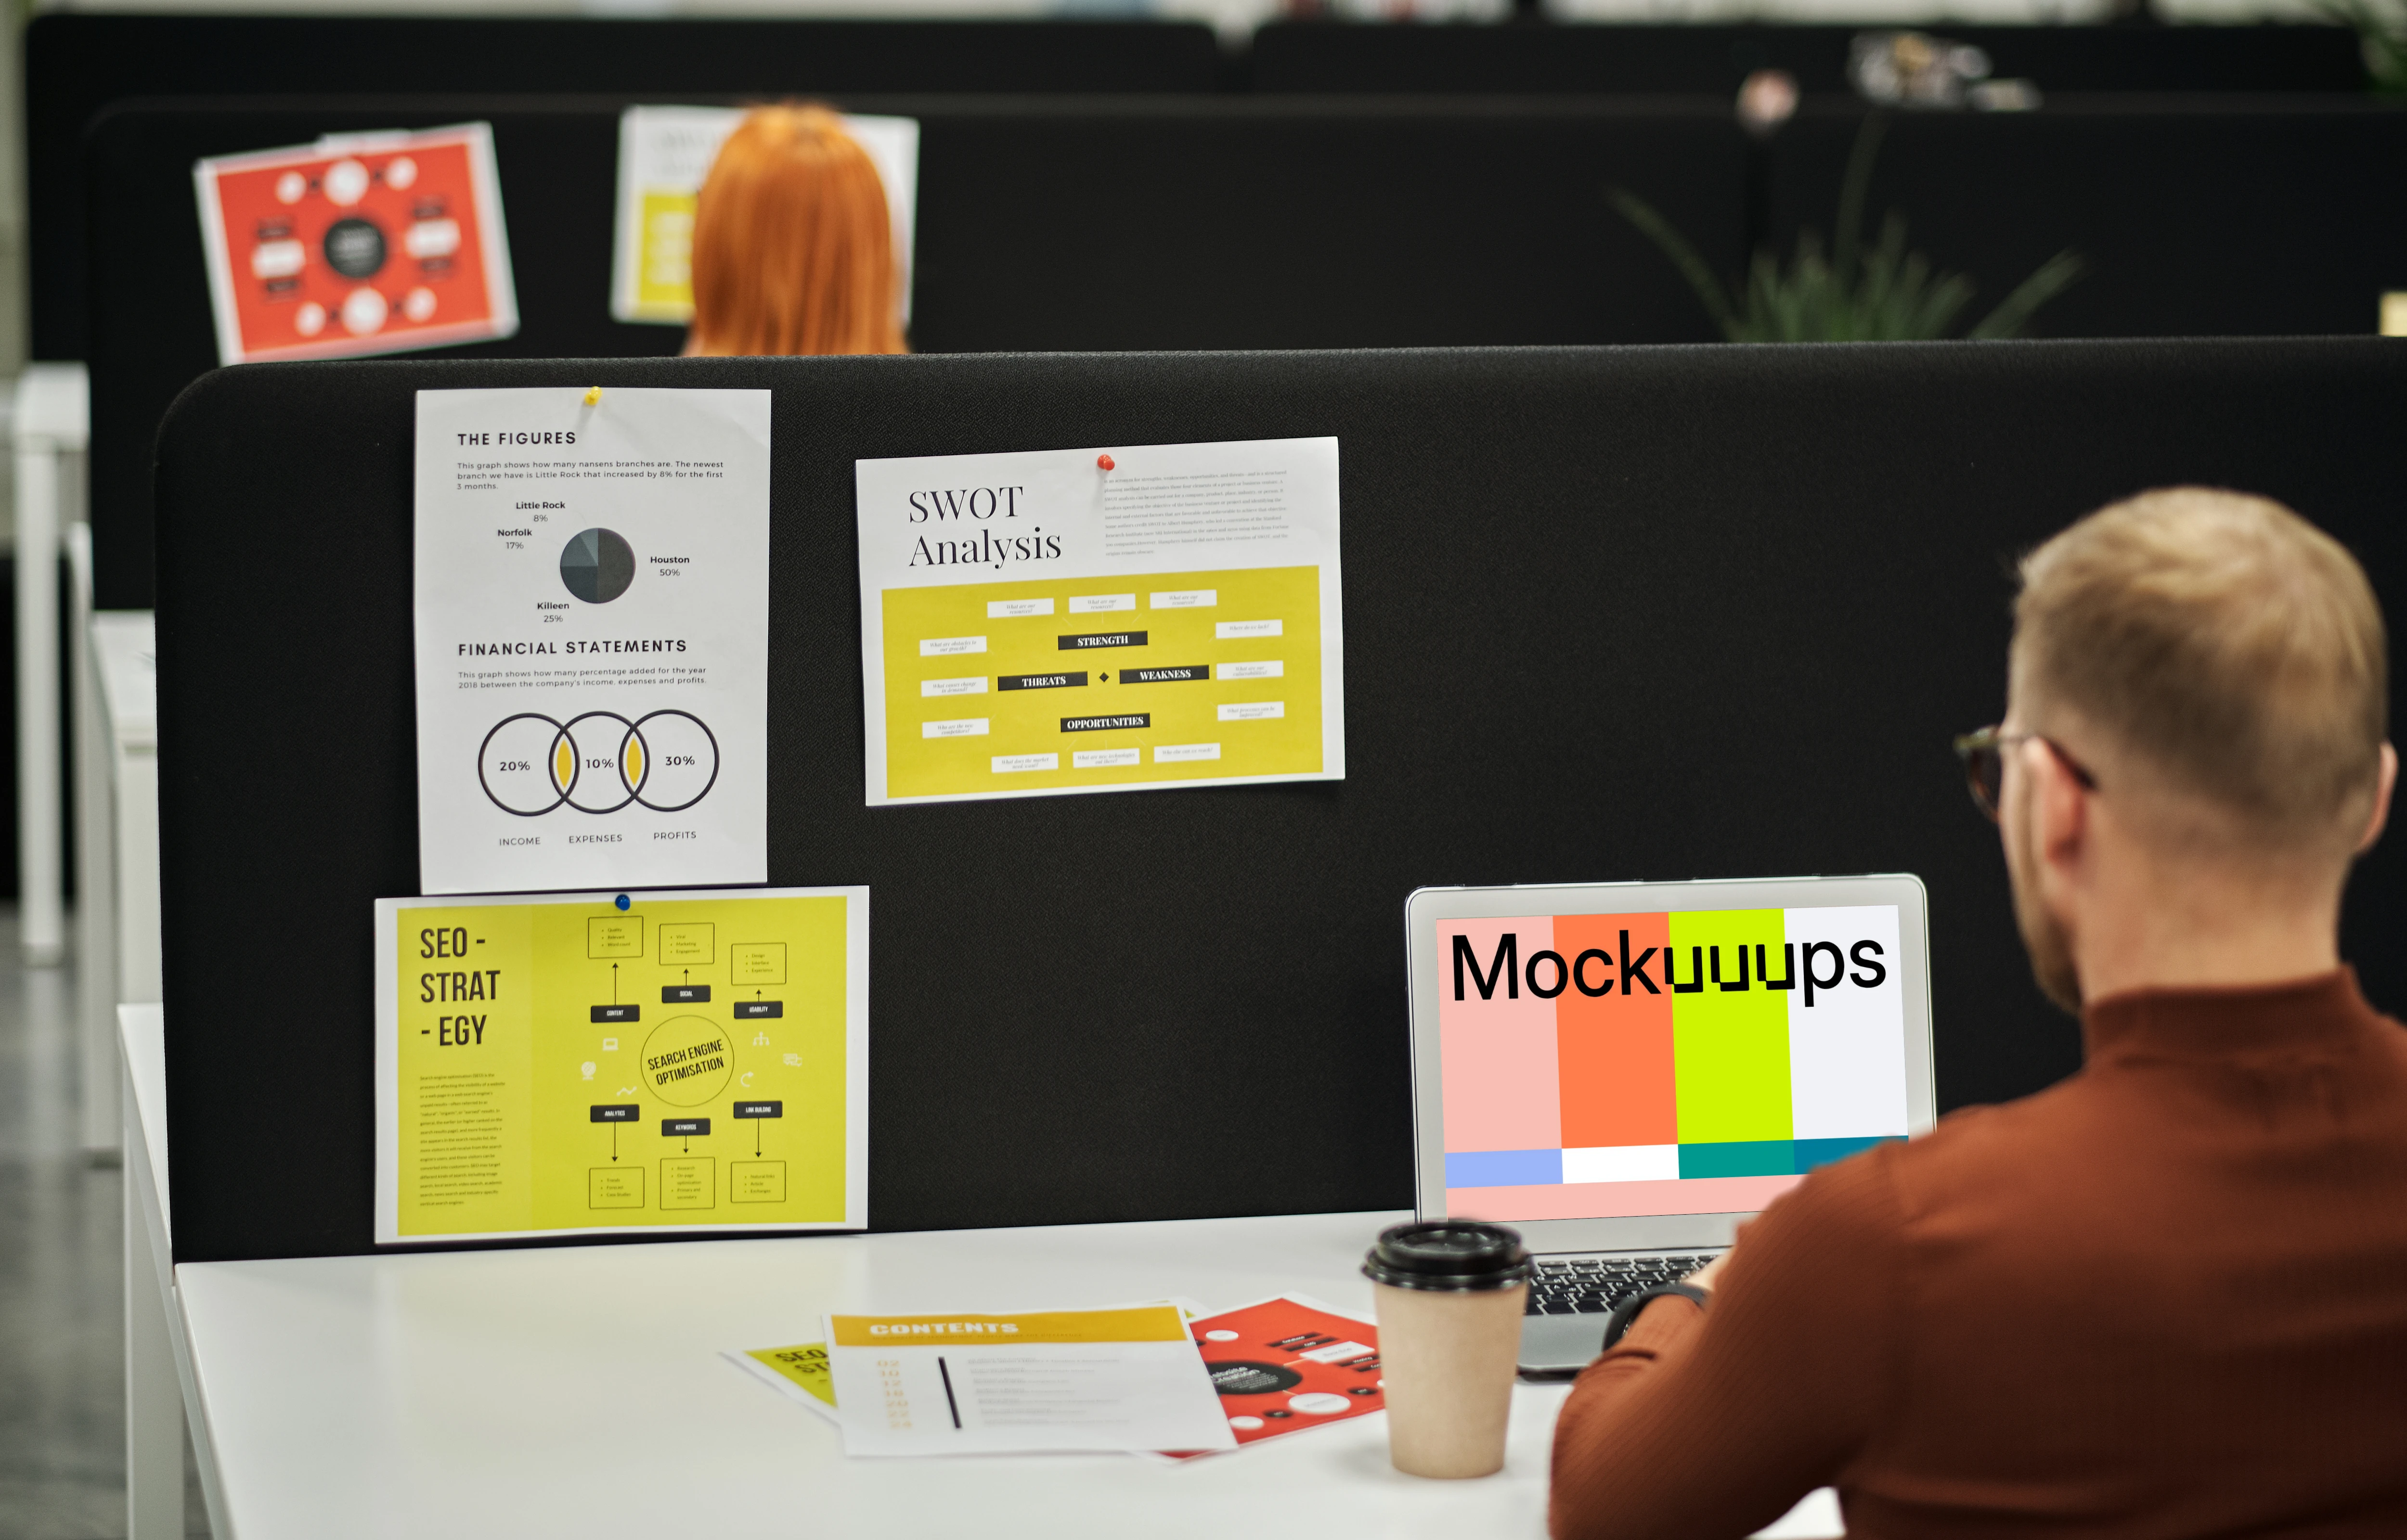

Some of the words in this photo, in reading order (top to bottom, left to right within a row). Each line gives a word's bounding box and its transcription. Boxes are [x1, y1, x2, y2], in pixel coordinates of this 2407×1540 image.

[457, 433, 489, 445] THE
[499, 432, 575, 445] FIGURES
[477, 462, 501, 470] graph
[909, 486, 1022, 523] SWOT
[909, 526, 1061, 568] Analysis
[1077, 635, 1128, 646] STRENGTH
[459, 642, 557, 656] FINANCIAL
[566, 640, 686, 654] STATEMENTS
[1139, 669, 1191, 680] WEAKNESS
[1022, 676, 1066, 687] THREATS
[1067, 716, 1143, 729] OPPORTUNITIES
[500, 761, 530, 771] 20%
[586, 758, 614, 768] 10%
[666, 756, 695, 766] 30%
[499, 837, 540, 846] INCOME
[569, 834, 622, 843] EXPENSES
[654, 831, 696, 839] PROFITS
[420, 927, 467, 959] SEO
[1452, 930, 1886, 1007] Mockuuups
[421, 970, 501, 1003] STRAT
[440, 1014, 487, 1046] EGY
[647, 1050, 686, 1070] SEARCH
[687, 1040, 724, 1059] ENGINE
[656, 1057, 724, 1085] OPTIMISATION
[869, 1322, 1018, 1335] CONTENTS
[775, 1349, 828, 1362] SEO
